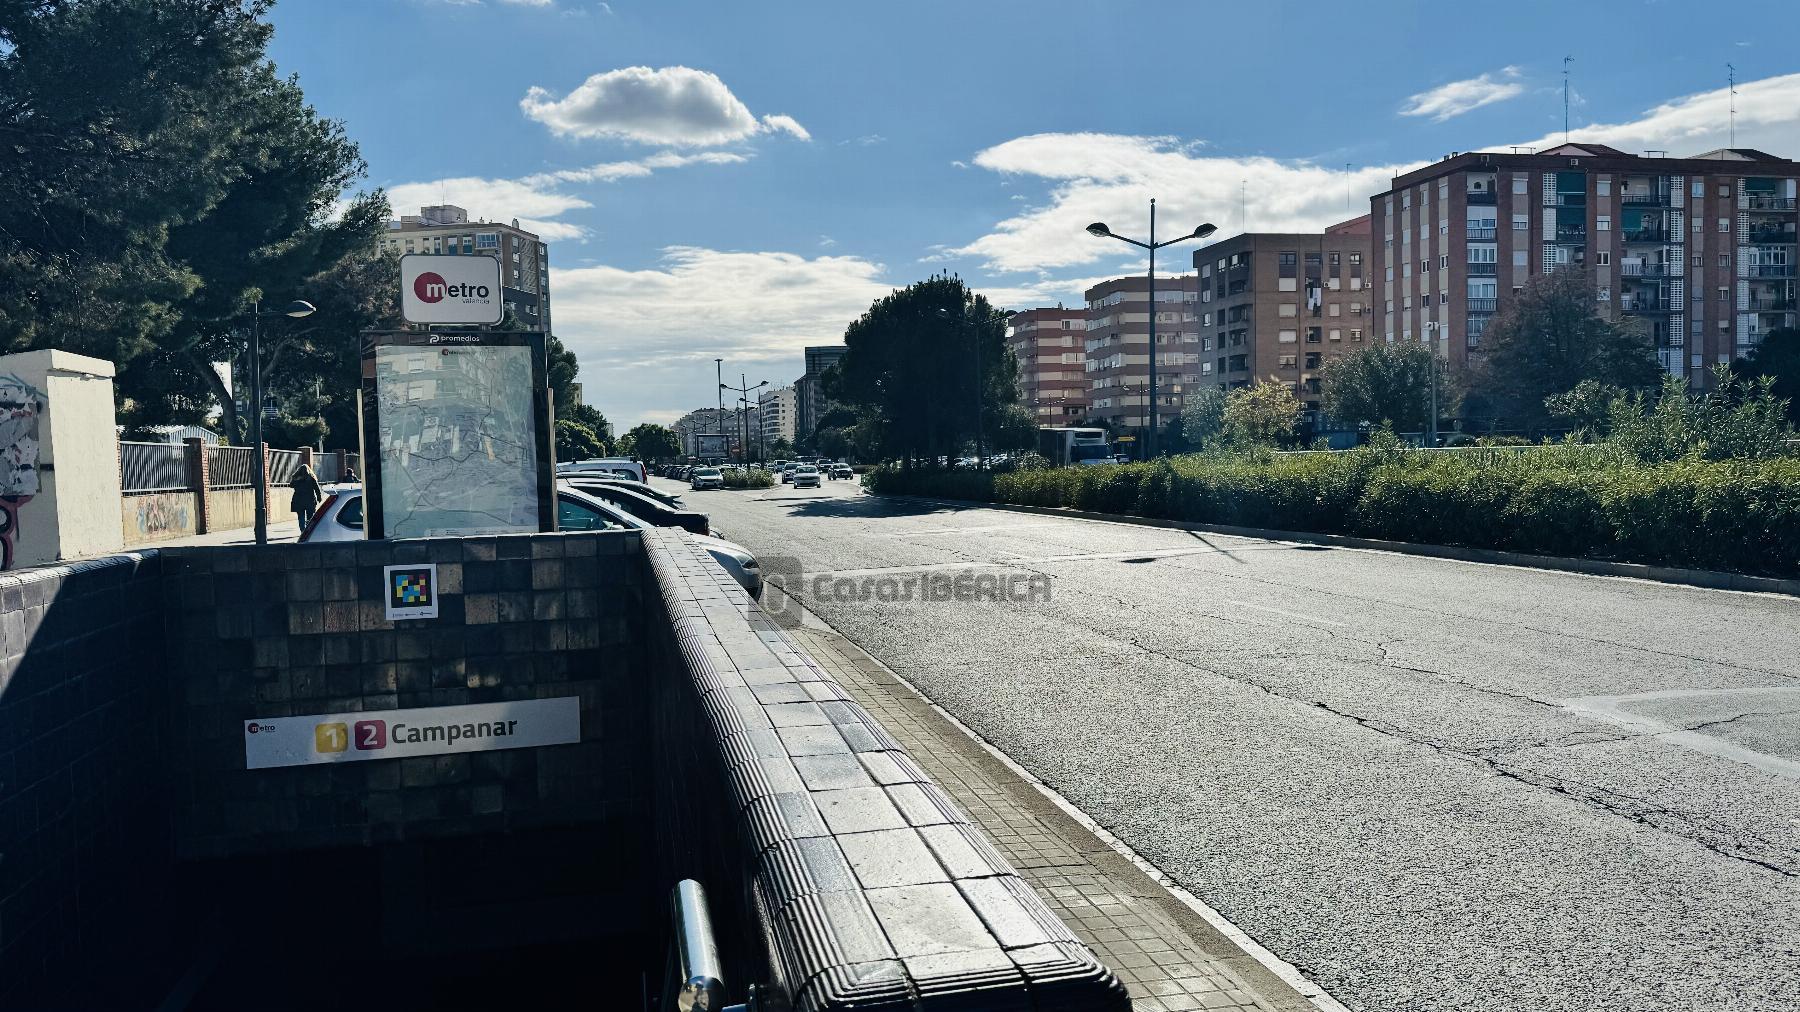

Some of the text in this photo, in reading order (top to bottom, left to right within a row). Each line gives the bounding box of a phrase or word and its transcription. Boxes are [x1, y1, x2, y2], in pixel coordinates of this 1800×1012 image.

[426, 282, 489, 299] metro
[441, 335, 480, 343] promedios
[325, 719, 518, 748] 1 2 Campanar
